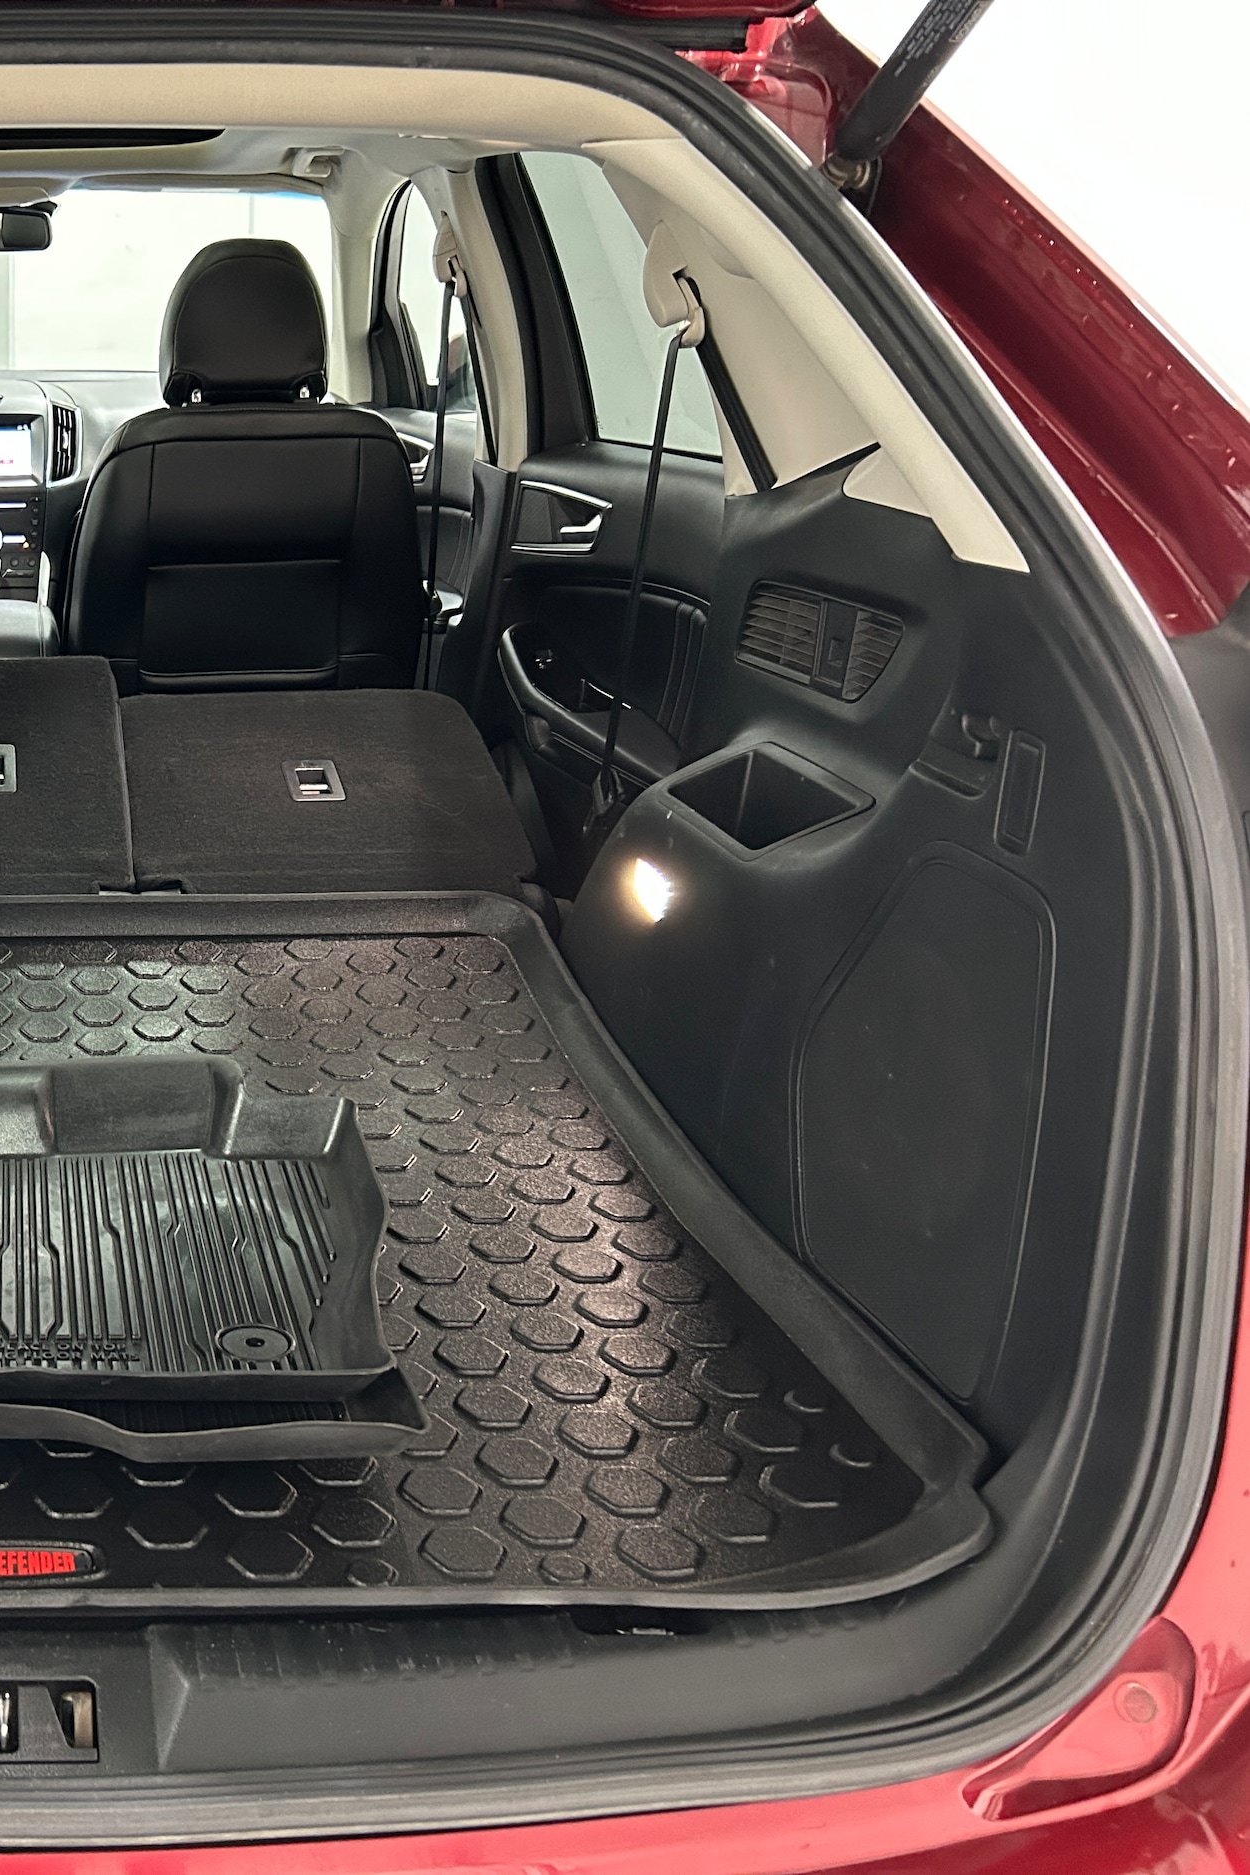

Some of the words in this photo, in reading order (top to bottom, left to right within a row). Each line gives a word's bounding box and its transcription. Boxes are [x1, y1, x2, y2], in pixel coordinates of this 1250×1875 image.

[57, 1343, 84, 1351] ON
[93, 1343, 127, 1351] TOP
[23, 1351, 82, 1360] FLOOR
[90, 1352, 140, 1361] MATS
